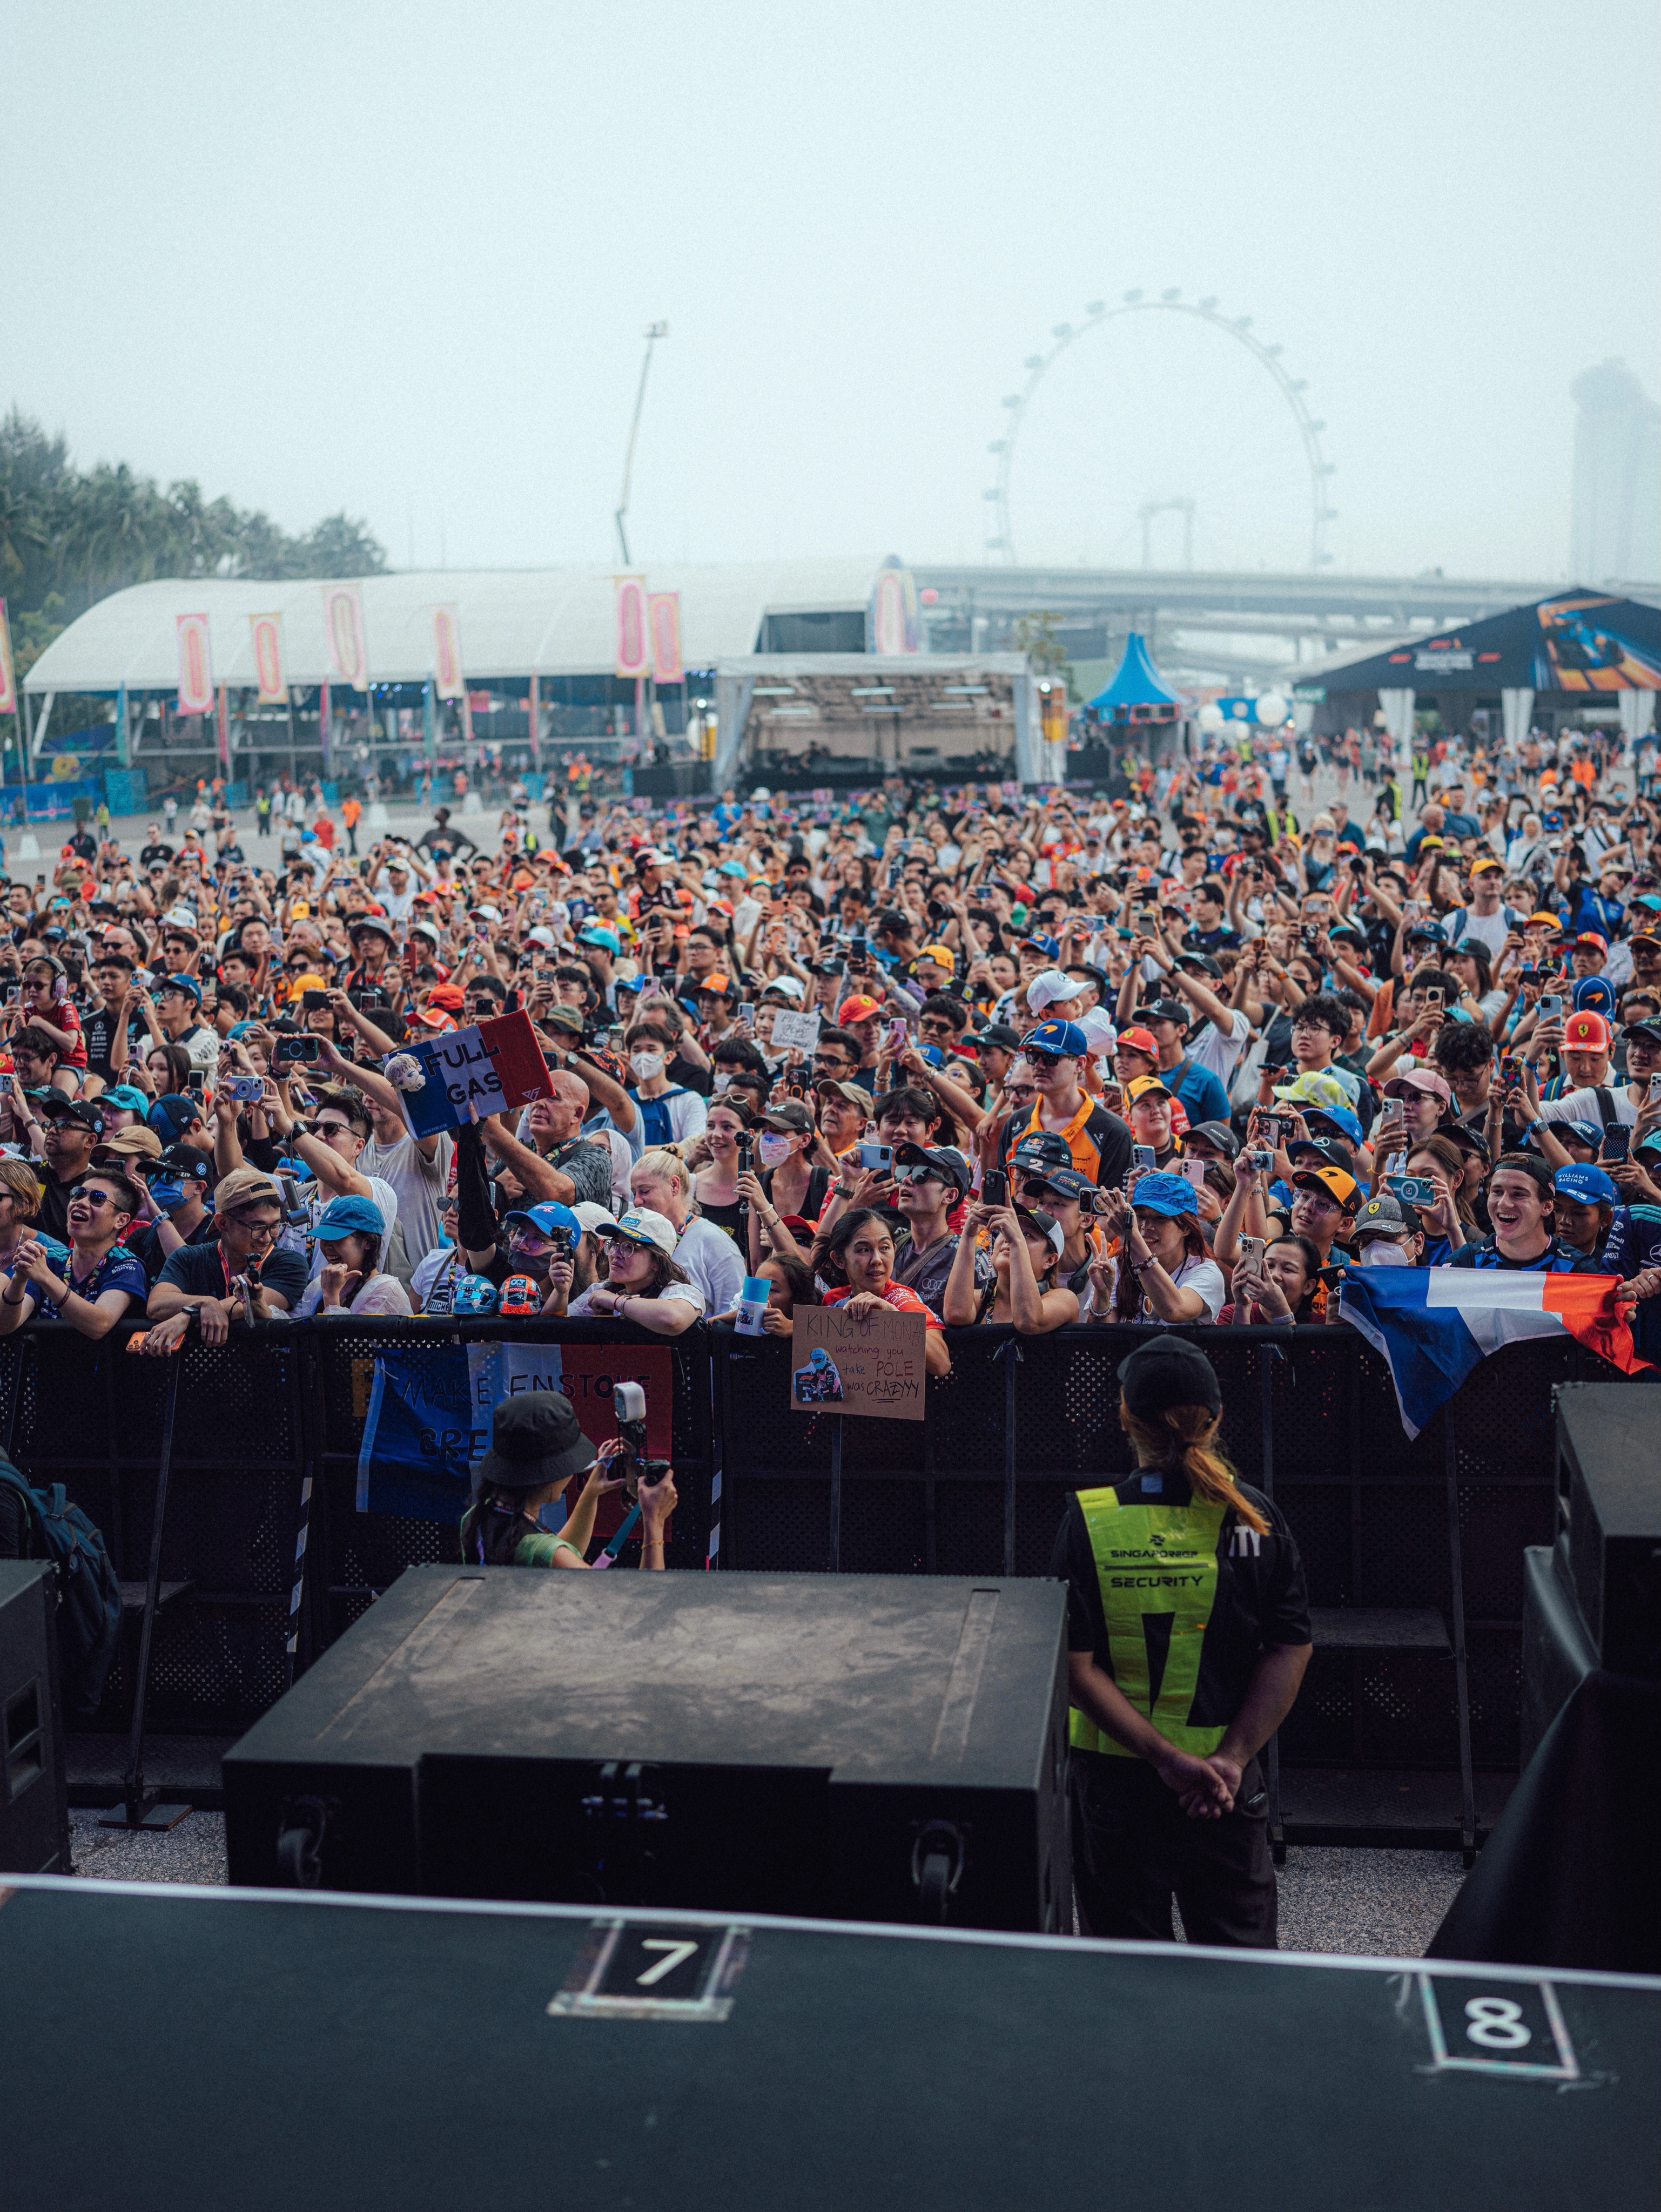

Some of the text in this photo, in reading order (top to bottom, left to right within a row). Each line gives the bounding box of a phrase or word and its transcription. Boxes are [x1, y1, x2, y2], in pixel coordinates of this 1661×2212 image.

[423, 1038, 501, 1076] FULL
[446, 1071, 503, 1105] GAS
[197, 1163, 206, 1175] hp
[1028, 1158, 1043, 1172] 2
[1558, 1173, 1589, 1181] WILLIAMS
[1566, 1189, 1588, 1200] 23
[111, 1265, 136, 1274] BONVOY
[893, 1296, 914, 1305] TECHNOLOG
[920, 1291, 944, 1300] Revolu
[807, 1314, 925, 1346] KING OF MONZA
[836, 1344, 904, 1359] watching you
[842, 1361, 914, 1377] take POLE
[401, 1374, 651, 1408] MAKE ENSTOE
[848, 1380, 919, 1398] was CRAZYYY
[419, 1428, 490, 1461] GRE
[1111, 1576, 1203, 1588] SECURITY
[636, 1938, 699, 1985] 7
[1464, 1997, 1532, 2048] 8
